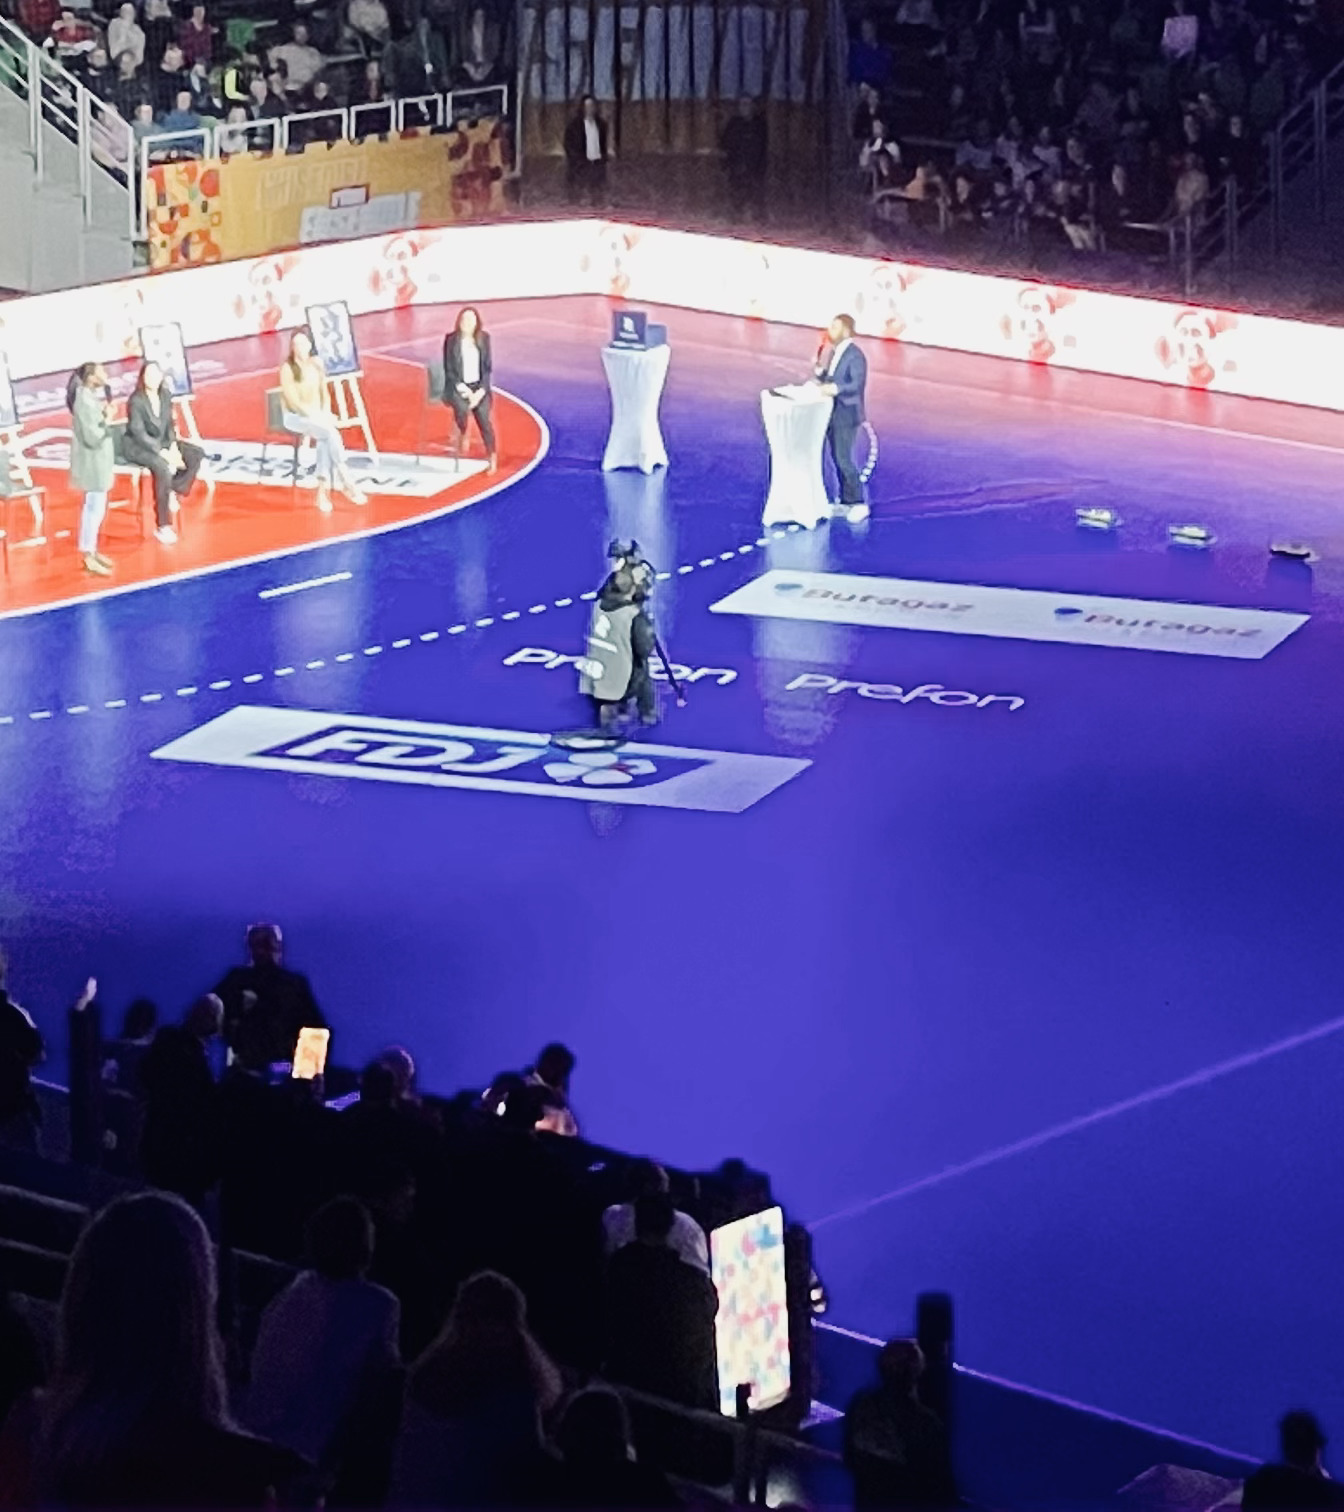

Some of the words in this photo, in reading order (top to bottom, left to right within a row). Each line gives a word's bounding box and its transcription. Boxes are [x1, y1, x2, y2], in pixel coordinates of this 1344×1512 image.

[802, 588, 975, 614] Butagaz
[1083, 612, 1263, 638] Butagaz
[283, 729, 548, 774] FDJ
